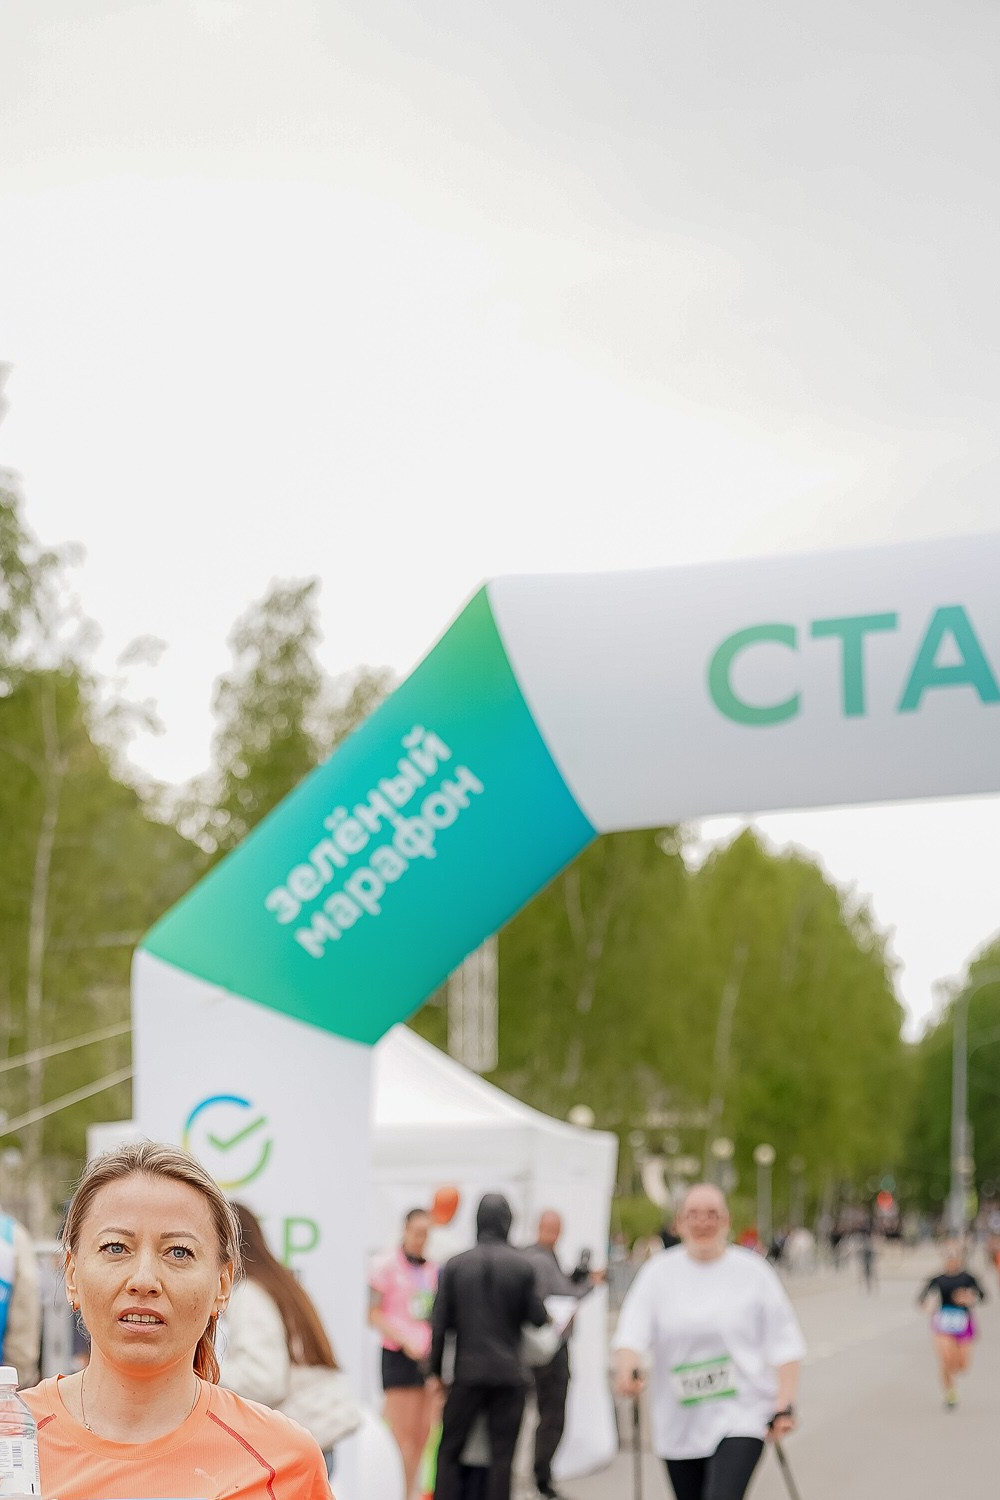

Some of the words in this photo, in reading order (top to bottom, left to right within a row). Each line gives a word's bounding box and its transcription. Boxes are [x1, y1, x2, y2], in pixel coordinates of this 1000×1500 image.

[706, 604, 1000, 728] СТА
[264, 724, 453, 926] зелёный
[294, 764, 485, 960] марафон
